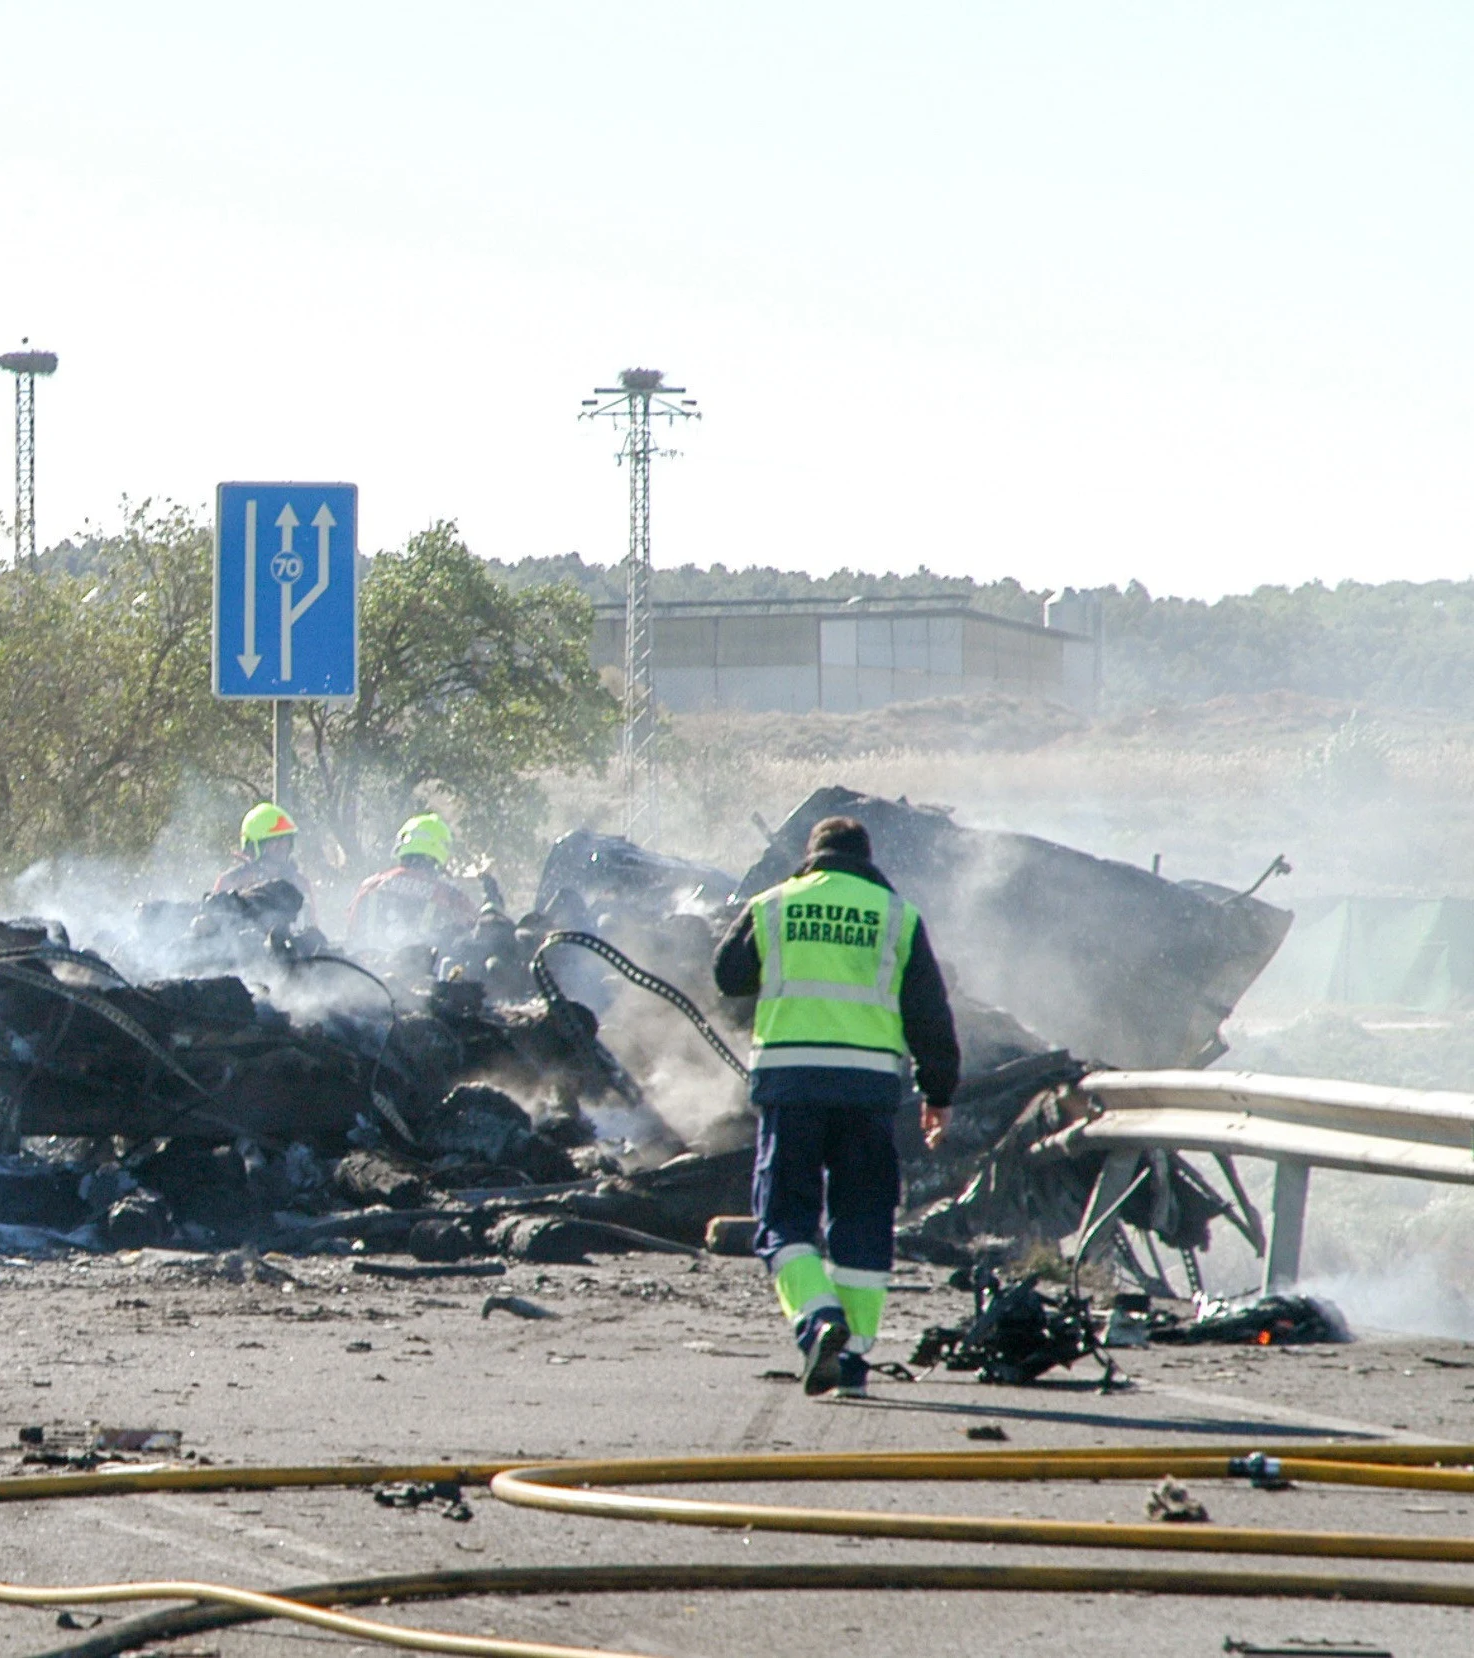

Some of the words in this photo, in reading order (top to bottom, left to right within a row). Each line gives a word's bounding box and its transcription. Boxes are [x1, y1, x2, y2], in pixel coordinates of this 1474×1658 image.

[273, 559, 300, 577] 70
[786, 903, 880, 925] GRUAS
[786, 921, 878, 948] BARRAGAN
